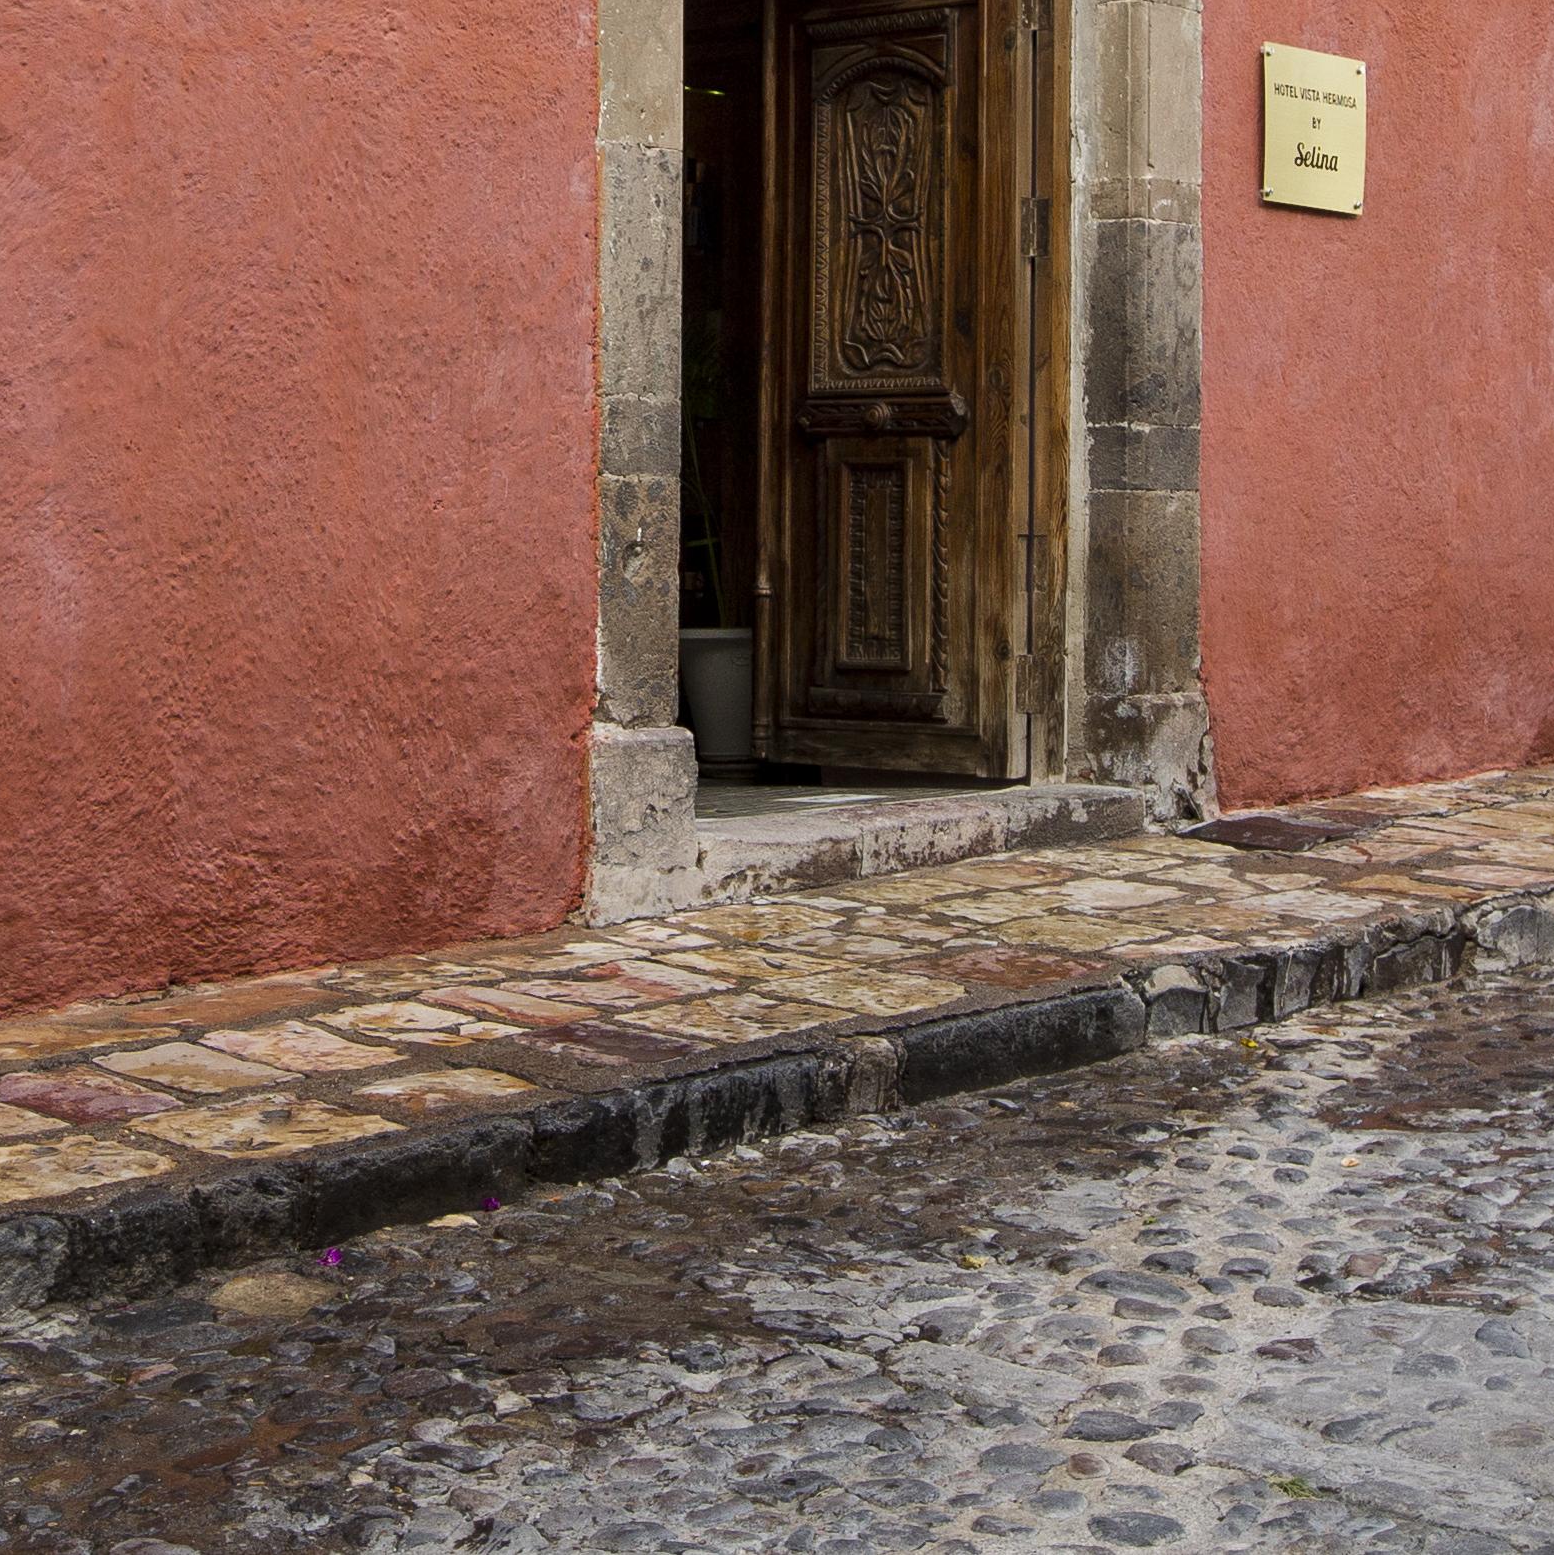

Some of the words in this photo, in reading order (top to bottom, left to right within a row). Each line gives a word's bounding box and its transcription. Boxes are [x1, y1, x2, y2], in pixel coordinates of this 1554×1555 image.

[1273, 82, 1299, 99] HOTEL
[1299, 87, 1321, 103] VISTA
[1322, 92, 1357, 109] HERMOSA
[1311, 116, 1322, 130] BY
[1294, 141, 1339, 172] Selina
